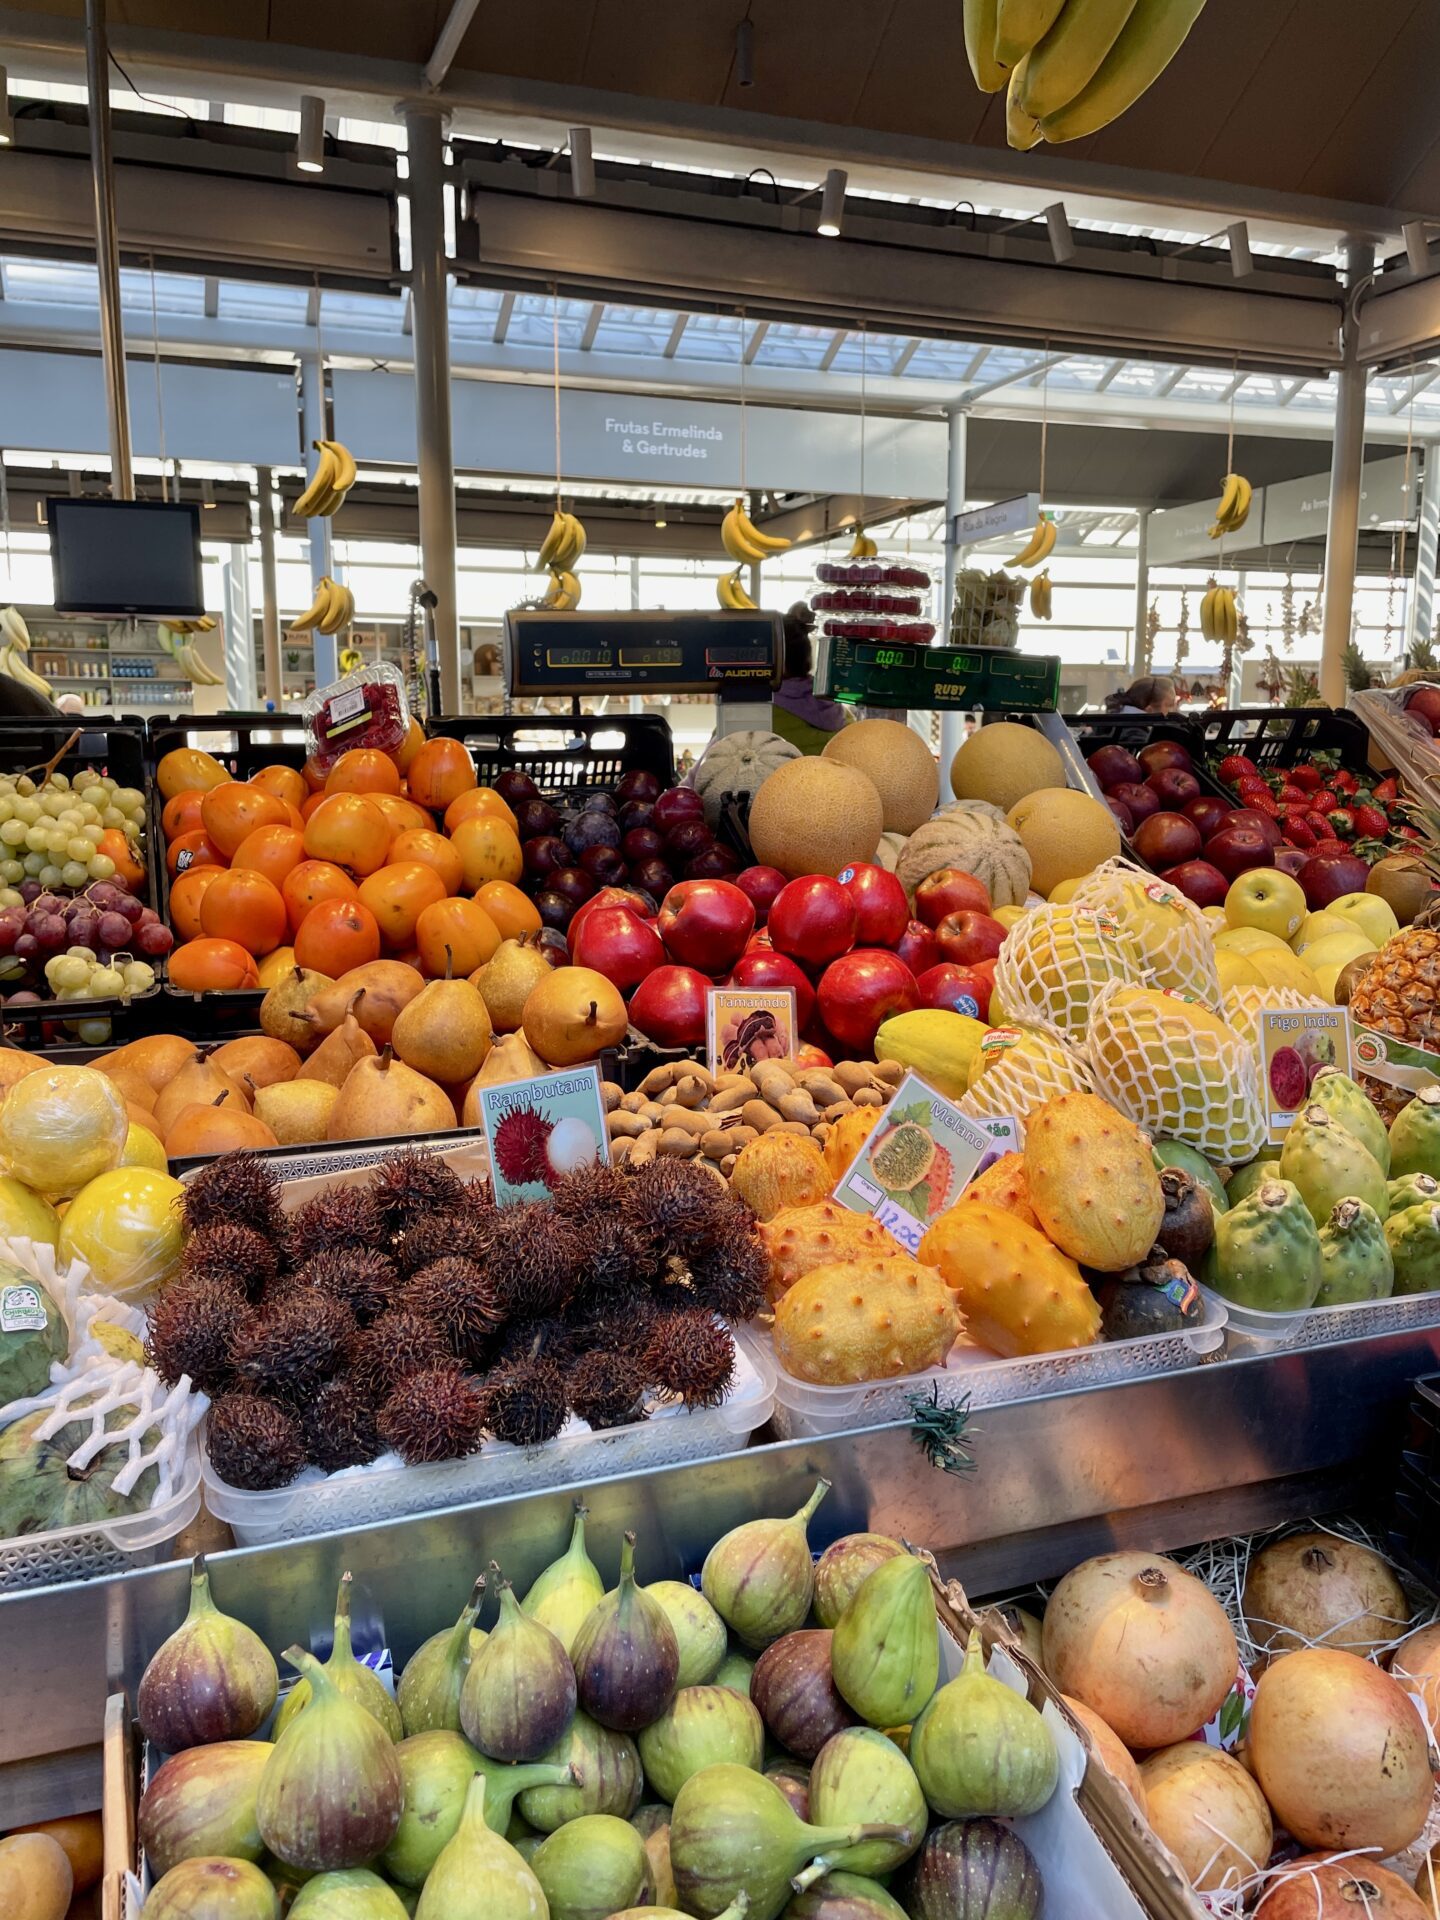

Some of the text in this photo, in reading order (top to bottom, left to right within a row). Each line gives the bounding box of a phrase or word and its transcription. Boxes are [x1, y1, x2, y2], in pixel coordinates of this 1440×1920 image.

[605, 418, 723, 441] Frutas Ermelinda
[622, 439, 708, 459] & Gertrudes
[725, 669, 773, 677] AUDITOR
[933, 683, 967, 696] RUBY
[718, 995, 788, 1008] Tamarindo
[1269, 1013, 1339, 1032] Figo India
[488, 1077, 593, 1110] Rambutam
[929, 1100, 985, 1151] Melano
